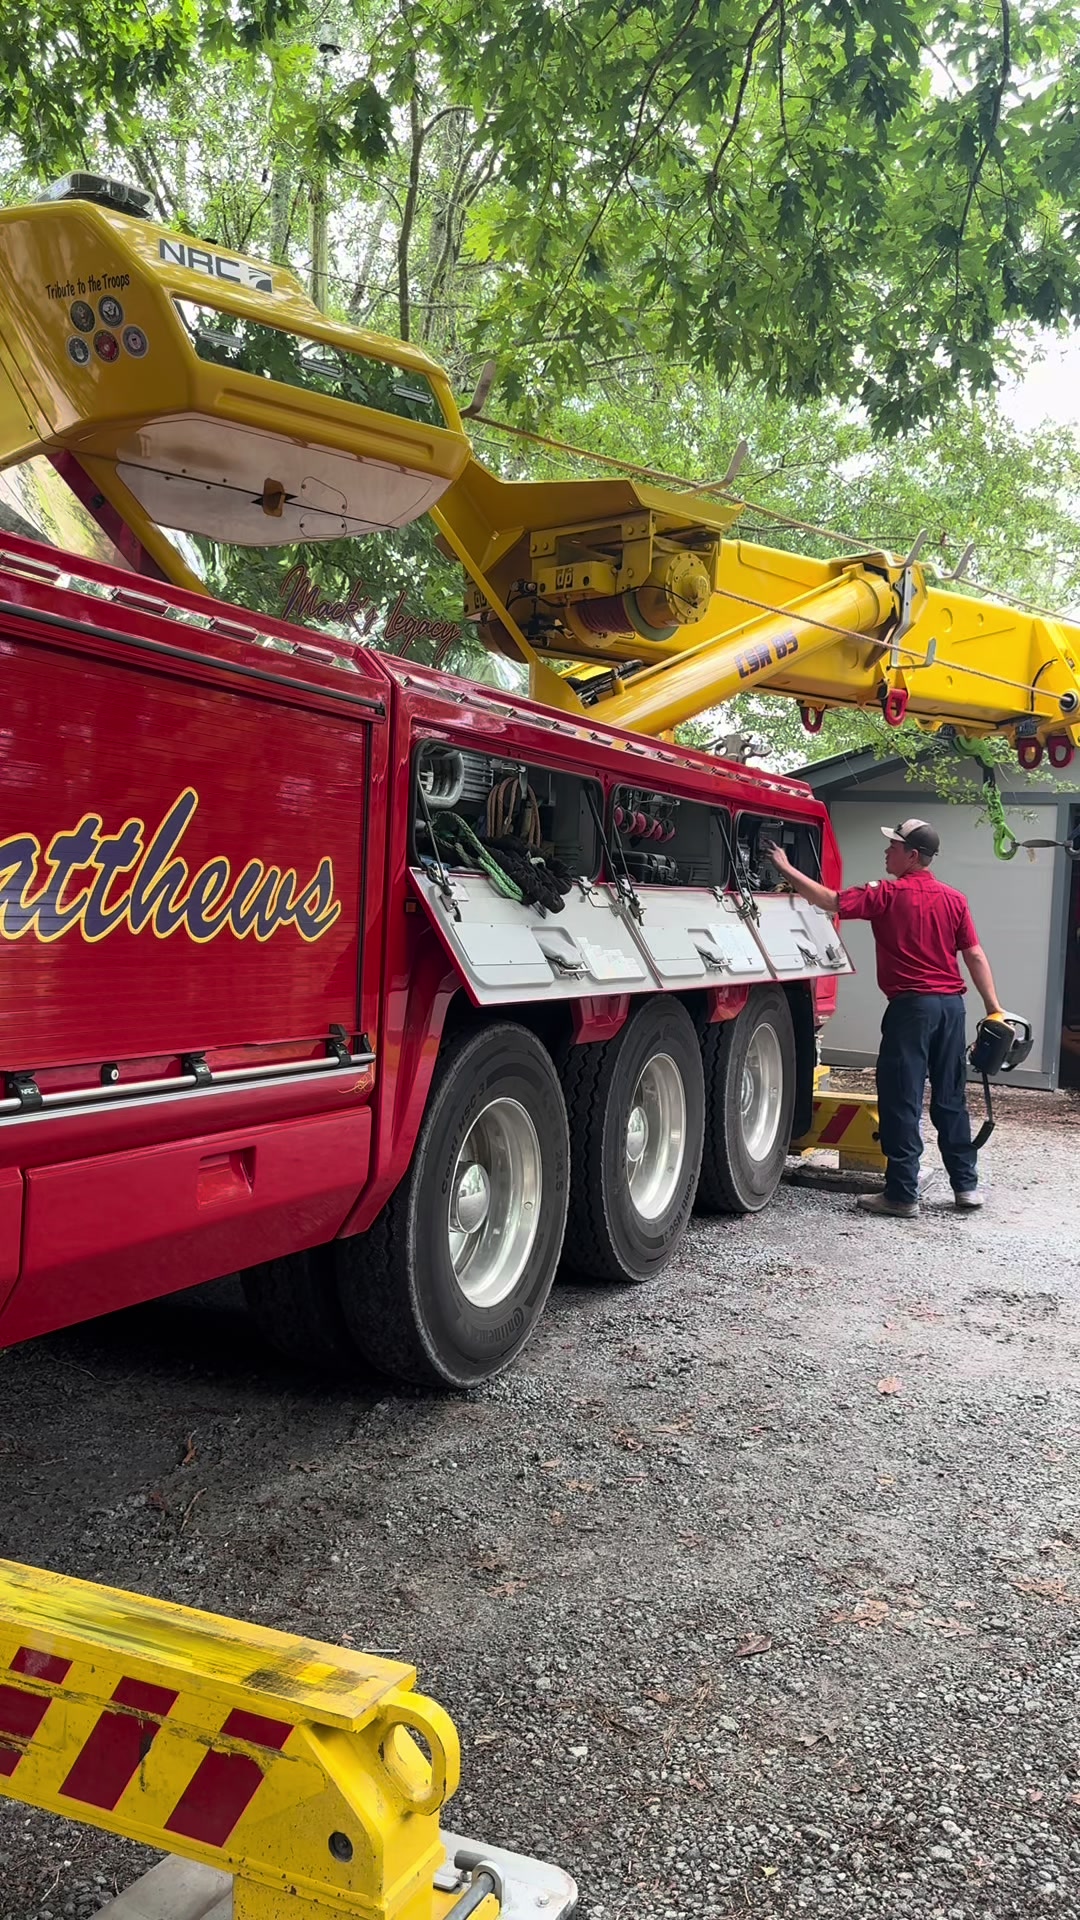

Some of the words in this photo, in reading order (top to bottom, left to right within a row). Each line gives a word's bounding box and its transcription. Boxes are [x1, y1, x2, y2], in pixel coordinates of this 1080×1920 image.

[160, 238, 240, 283] NRC
[45, 283, 75, 300] Tribute
[77, 280, 86, 294] to
[88, 275, 102, 291] the
[102, 272, 131, 291] Troops
[279, 564, 379, 637] Mack's
